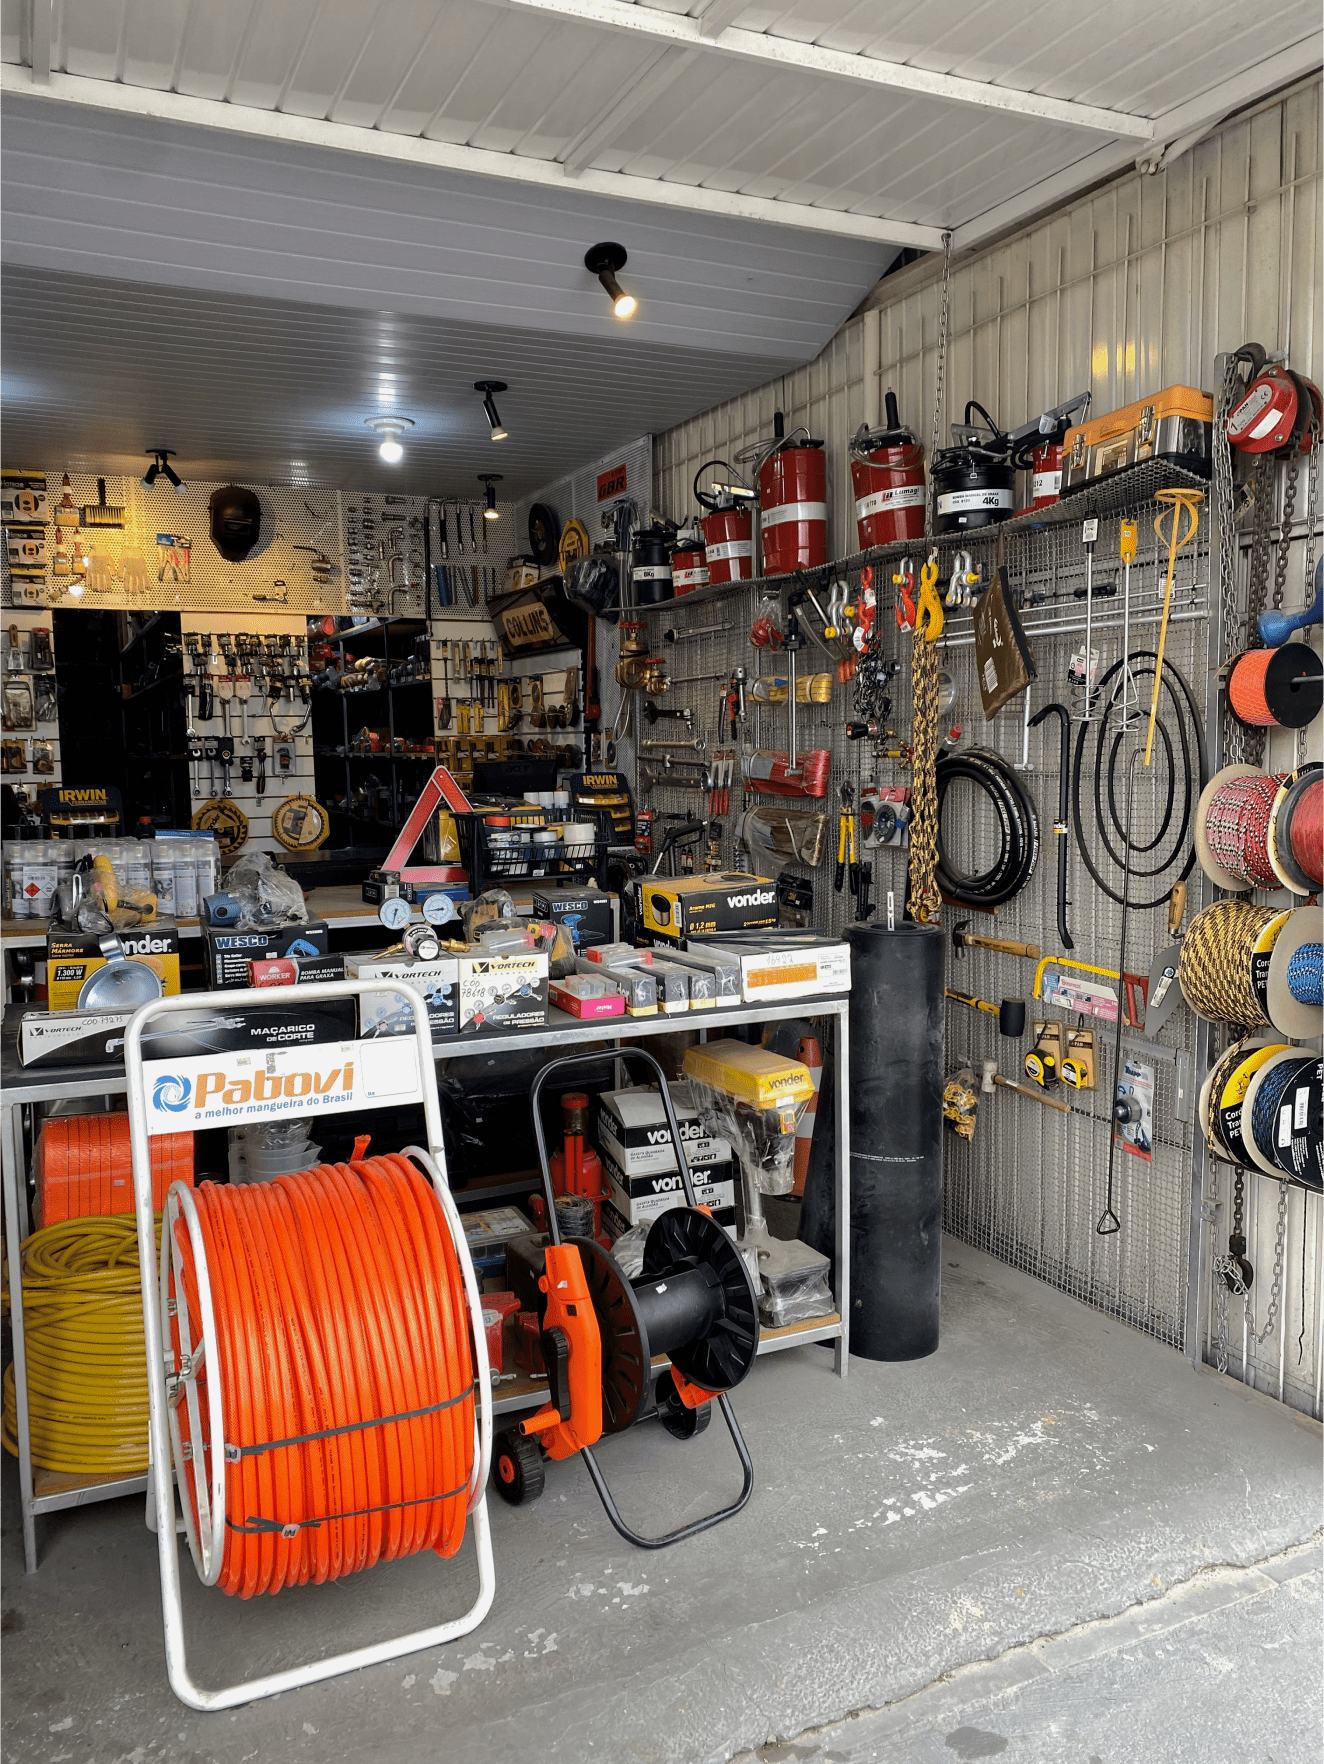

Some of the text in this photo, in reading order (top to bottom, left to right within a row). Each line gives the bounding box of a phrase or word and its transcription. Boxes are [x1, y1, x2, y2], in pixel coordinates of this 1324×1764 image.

[982, 496, 999, 507] 4Kg
[506, 609, 549, 639] COLLINS
[583, 774, 618, 785] IRWIN
[58, 788, 108, 802] IRWIN
[727, 889, 775, 909] vonder.
[552, 901, 589, 912] WESCO
[215, 935, 268, 949] WESCO
[490, 960, 536, 970] VORTECH
[75, 968, 84, 976] W
[259, 972, 291, 981] WORKER
[393, 970, 442, 979] VORTECH
[250, 1024, 315, 1036] MAÇARICO
[277, 1031, 315, 1041] CORTE
[1315, 1063, 1324, 1080] PET
[194, 1061, 354, 1108] Pabovi
[768, 1072, 804, 1090] vonder
[194, 1111, 202, 1119] a
[204, 1106, 244, 1118] melhor
[246, 1099, 304, 1113] mangueira
[306, 1096, 320, 1106] do
[322, 1091, 353, 1104] Brasil
